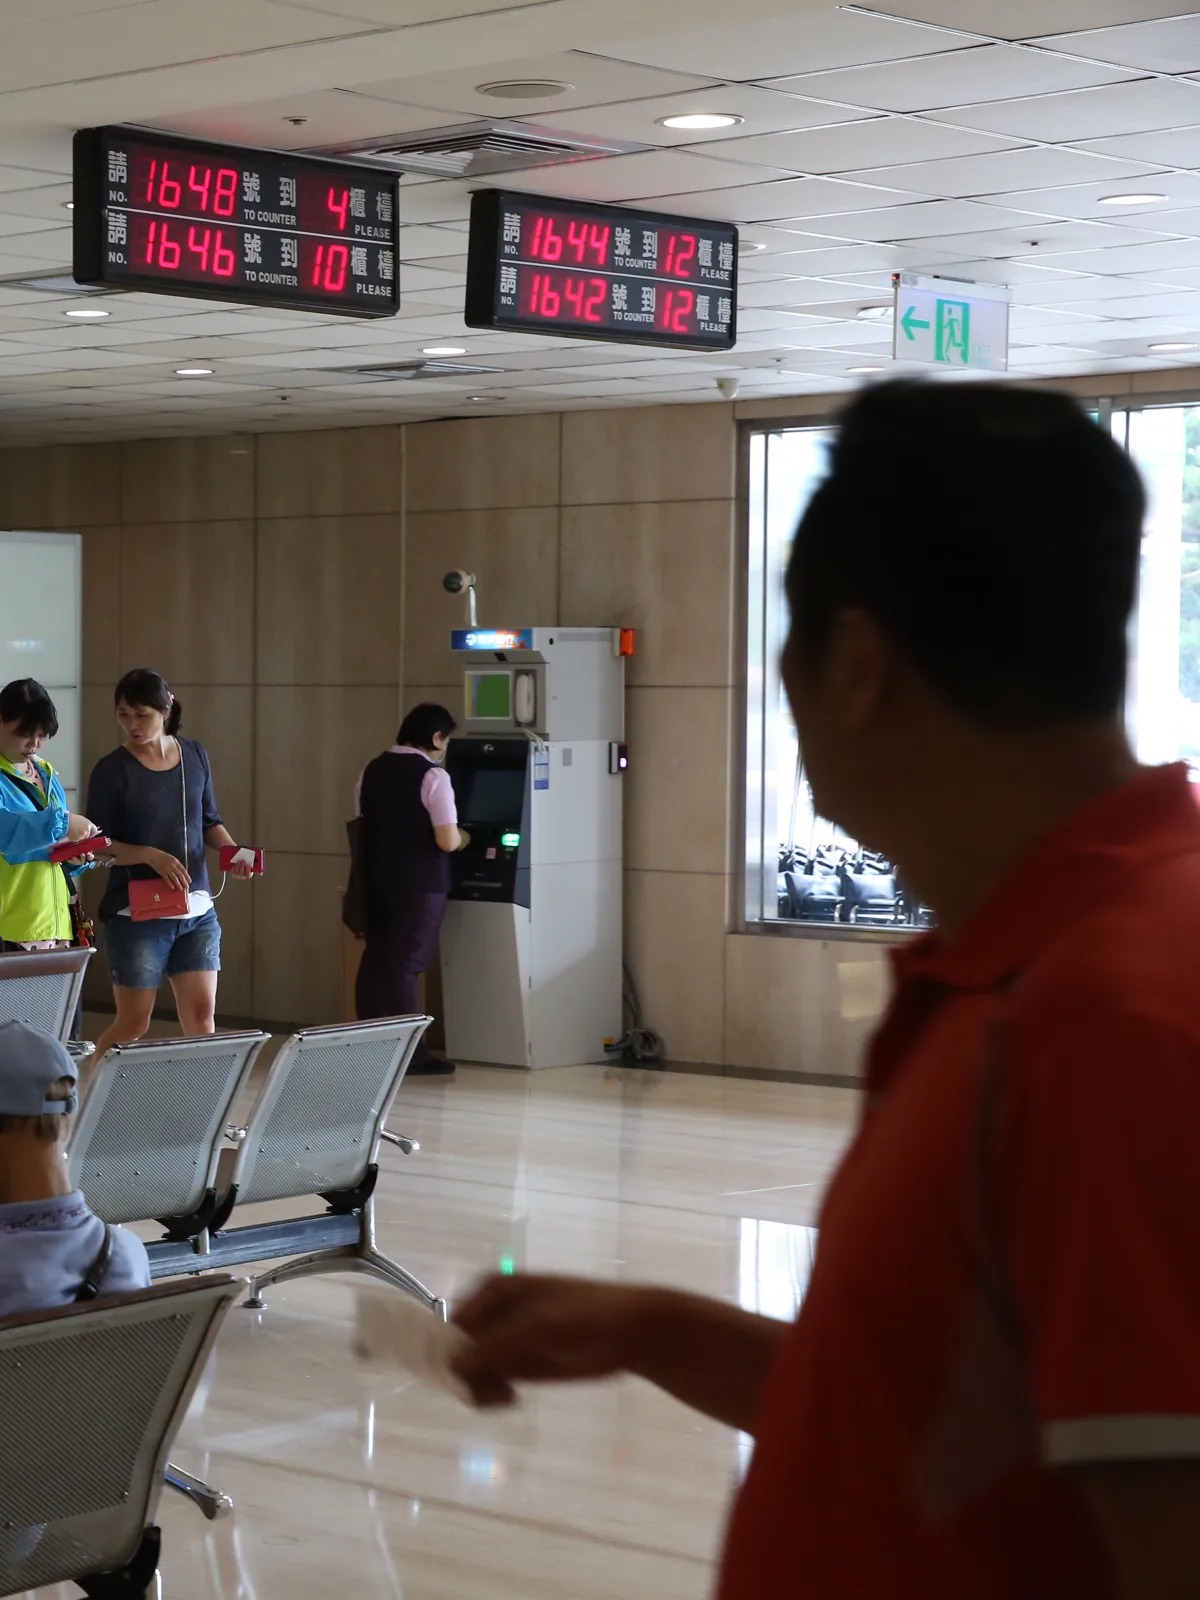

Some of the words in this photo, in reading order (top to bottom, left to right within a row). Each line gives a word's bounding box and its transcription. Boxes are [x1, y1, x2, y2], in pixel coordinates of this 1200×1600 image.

[108, 151, 128, 184] 請
[146, 160, 238, 217] 1648
[327, 187, 349, 231] 4
[109, 190, 128, 203] NO.
[244, 209, 256, 220] TO
[257, 210, 297, 226] COUNTER
[355, 224, 390, 239] PLEASE
[108, 212, 127, 245] 請
[146, 221, 235, 277] 1646
[313, 244, 348, 292] 10
[503, 212, 521, 243] 請
[530, 216, 611, 266] 1644
[664, 234, 696, 277] 12
[504, 244, 519, 255] NO.
[614, 256, 624, 267] TO
[625, 258, 657, 270] COUNTER
[700, 268, 730, 281] PLEASE
[108, 252, 127, 265] NO.
[245, 270, 257, 281] TO
[258, 272, 298, 286] COUNTER
[356, 284, 392, 297] PLEASE
[500, 266, 517, 295] 請
[529, 274, 607, 322] 1642
[662, 290, 694, 333] 12
[501, 296, 515, 306] NO.
[613, 311, 623, 321] TO
[624, 312, 655, 323] COUNTER
[700, 322, 727, 333] PLEASE
